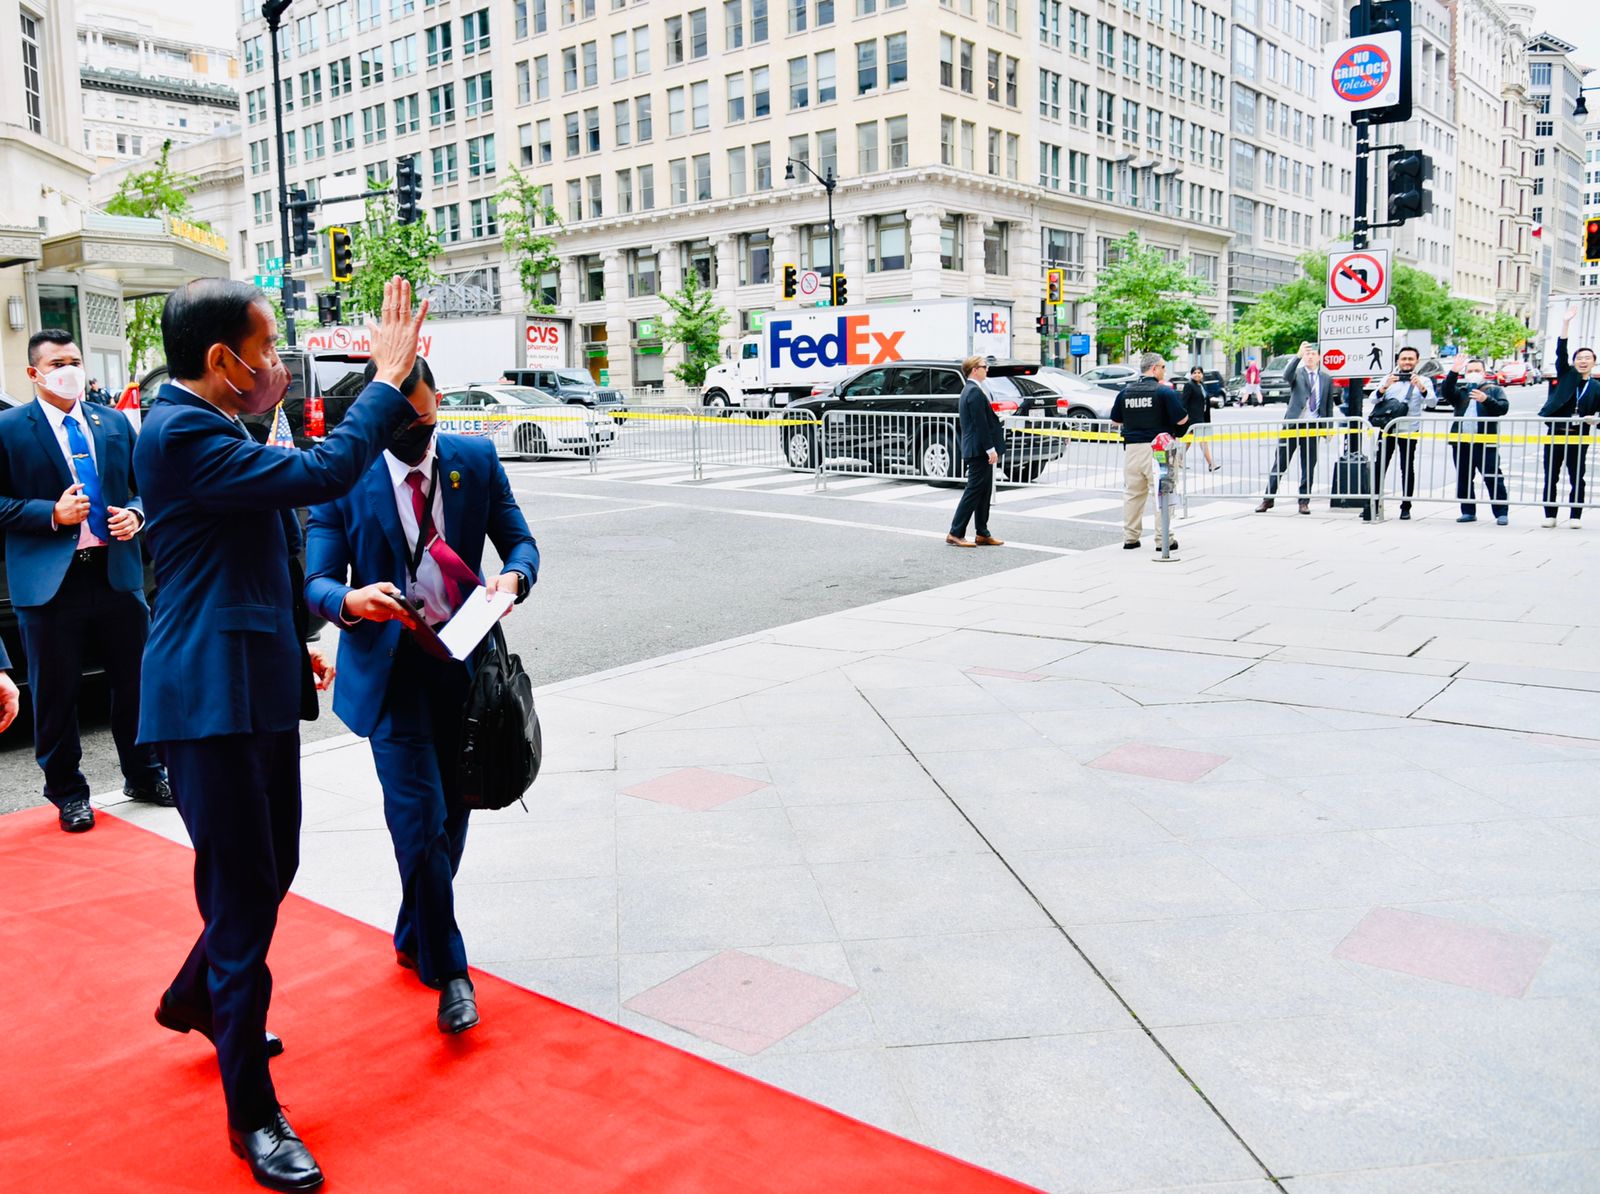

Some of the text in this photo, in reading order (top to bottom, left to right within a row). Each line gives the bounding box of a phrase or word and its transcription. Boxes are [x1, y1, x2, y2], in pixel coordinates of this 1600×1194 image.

[1354, 51, 1369, 64] NO
[1334, 61, 1388, 80] GRIDLOCK
[1338, 77, 1383, 93] (please)
[974, 311, 1007, 333] FedEx
[1326, 313, 1368, 322] TURNING
[526, 325, 558, 344] CVS
[1323, 325, 1370, 335] VEHICLES
[770, 315, 905, 368] FedEx
[528, 344, 558, 352] pharmacy
[1324, 355, 1344, 365] STOP
[1125, 397, 1153, 409] POLICE
[437, 420, 482, 431] OLICE
